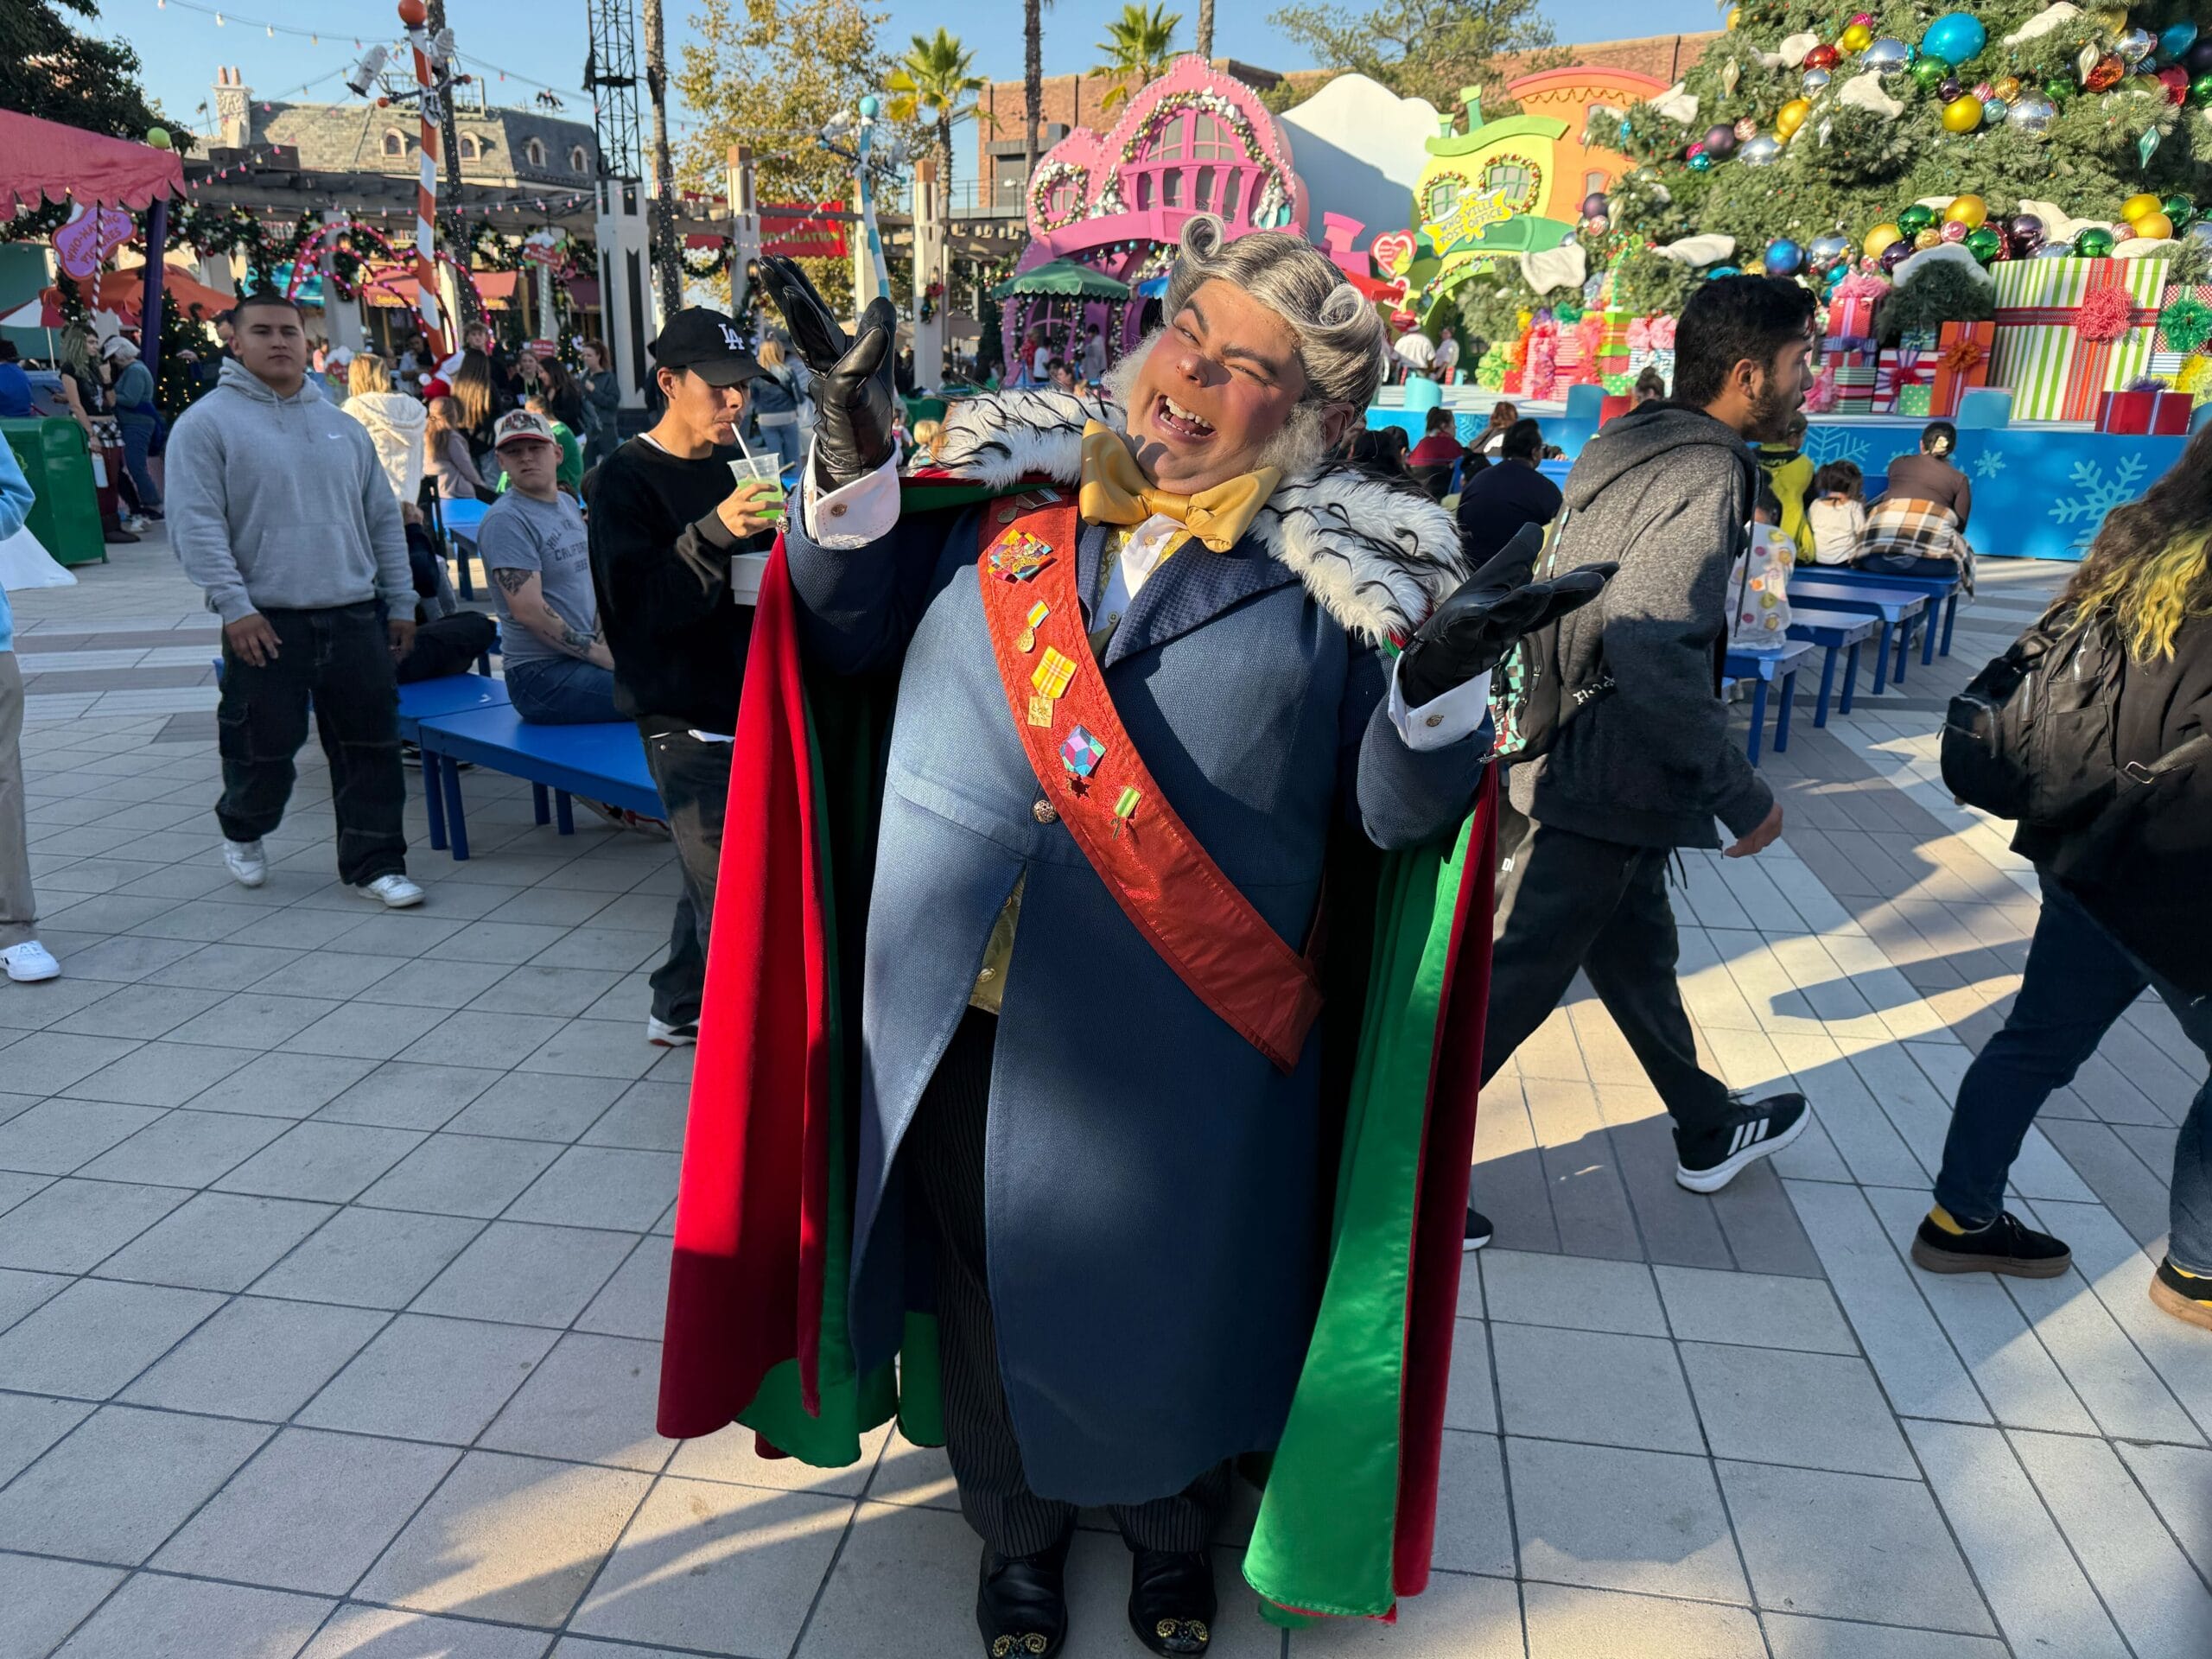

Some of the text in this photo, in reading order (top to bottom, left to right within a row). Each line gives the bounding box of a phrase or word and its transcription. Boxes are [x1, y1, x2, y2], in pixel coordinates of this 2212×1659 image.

[1440, 207, 1503, 245] POST OFFICE
[718, 323, 745, 350] LA
[546, 527, 562, 550] HILL
